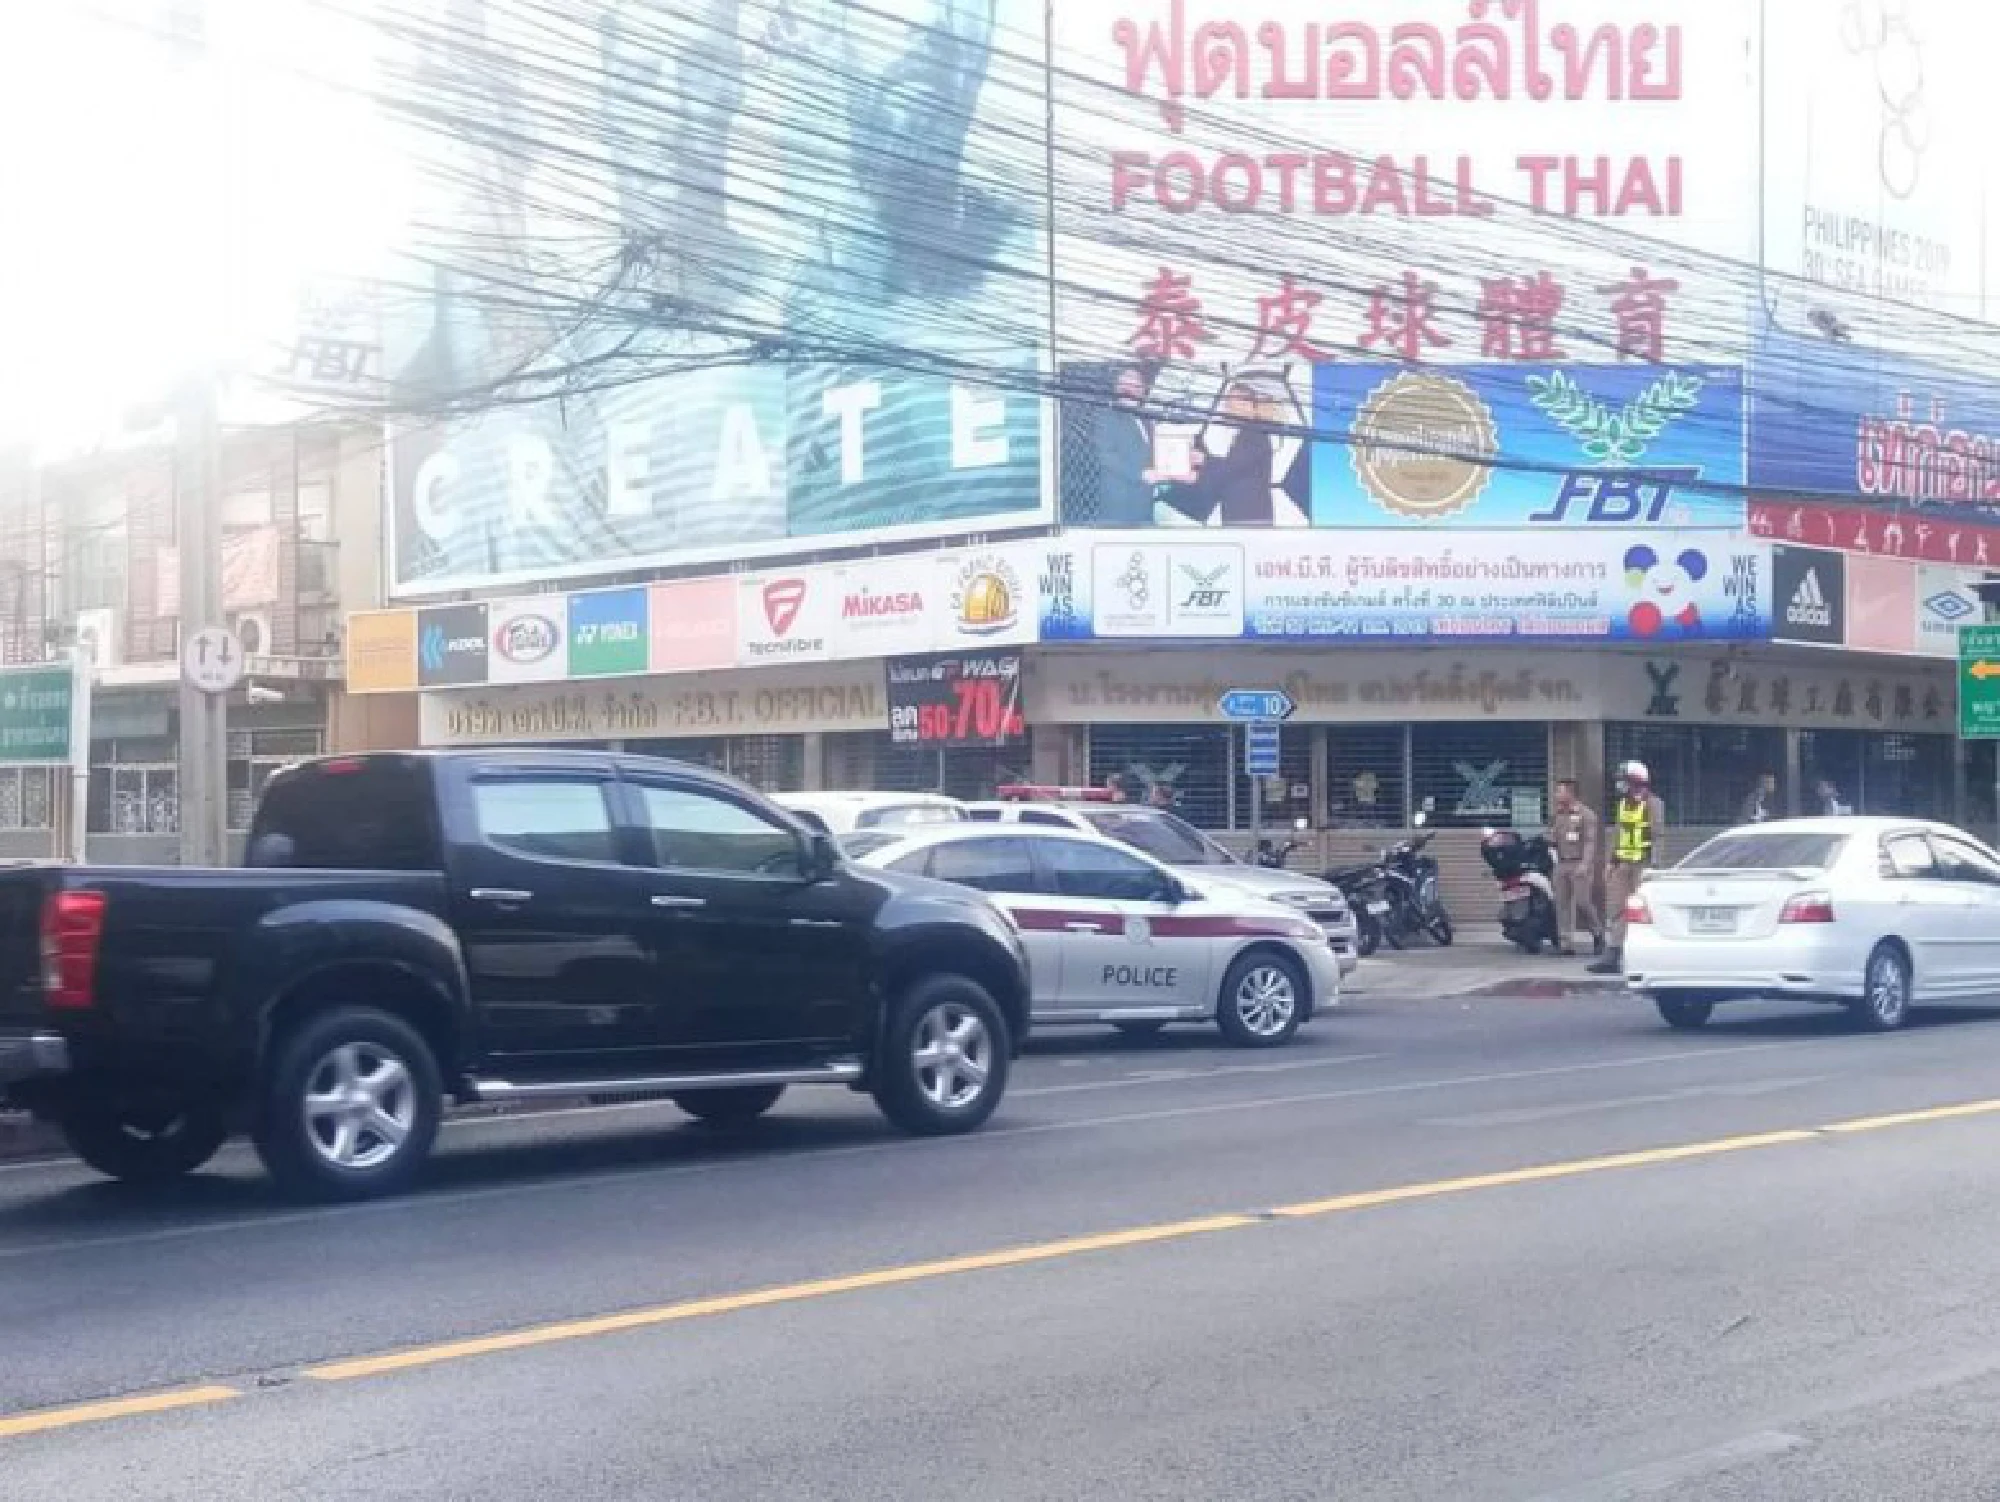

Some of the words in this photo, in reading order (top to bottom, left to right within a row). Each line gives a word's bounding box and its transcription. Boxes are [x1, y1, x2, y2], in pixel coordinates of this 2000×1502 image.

[1110, 151, 1494, 217] FOOTBALL
[1516, 155, 1683, 217] THAI
[414, 380, 1010, 541] CREATE
[1528, 465, 1705, 522] FBT
[1047, 554, 1074, 574] WE
[1731, 554, 1758, 576] WE
[1039, 575, 1073, 595] WIN
[1722, 575, 1757, 597] WIN
[1050, 596, 1074, 616] AS
[1734, 596, 1758, 616] AS
[754, 683, 884, 722] OFFICIAL
[1264, 695, 1282, 715] 10
[1102, 964, 1178, 988] POLICE
